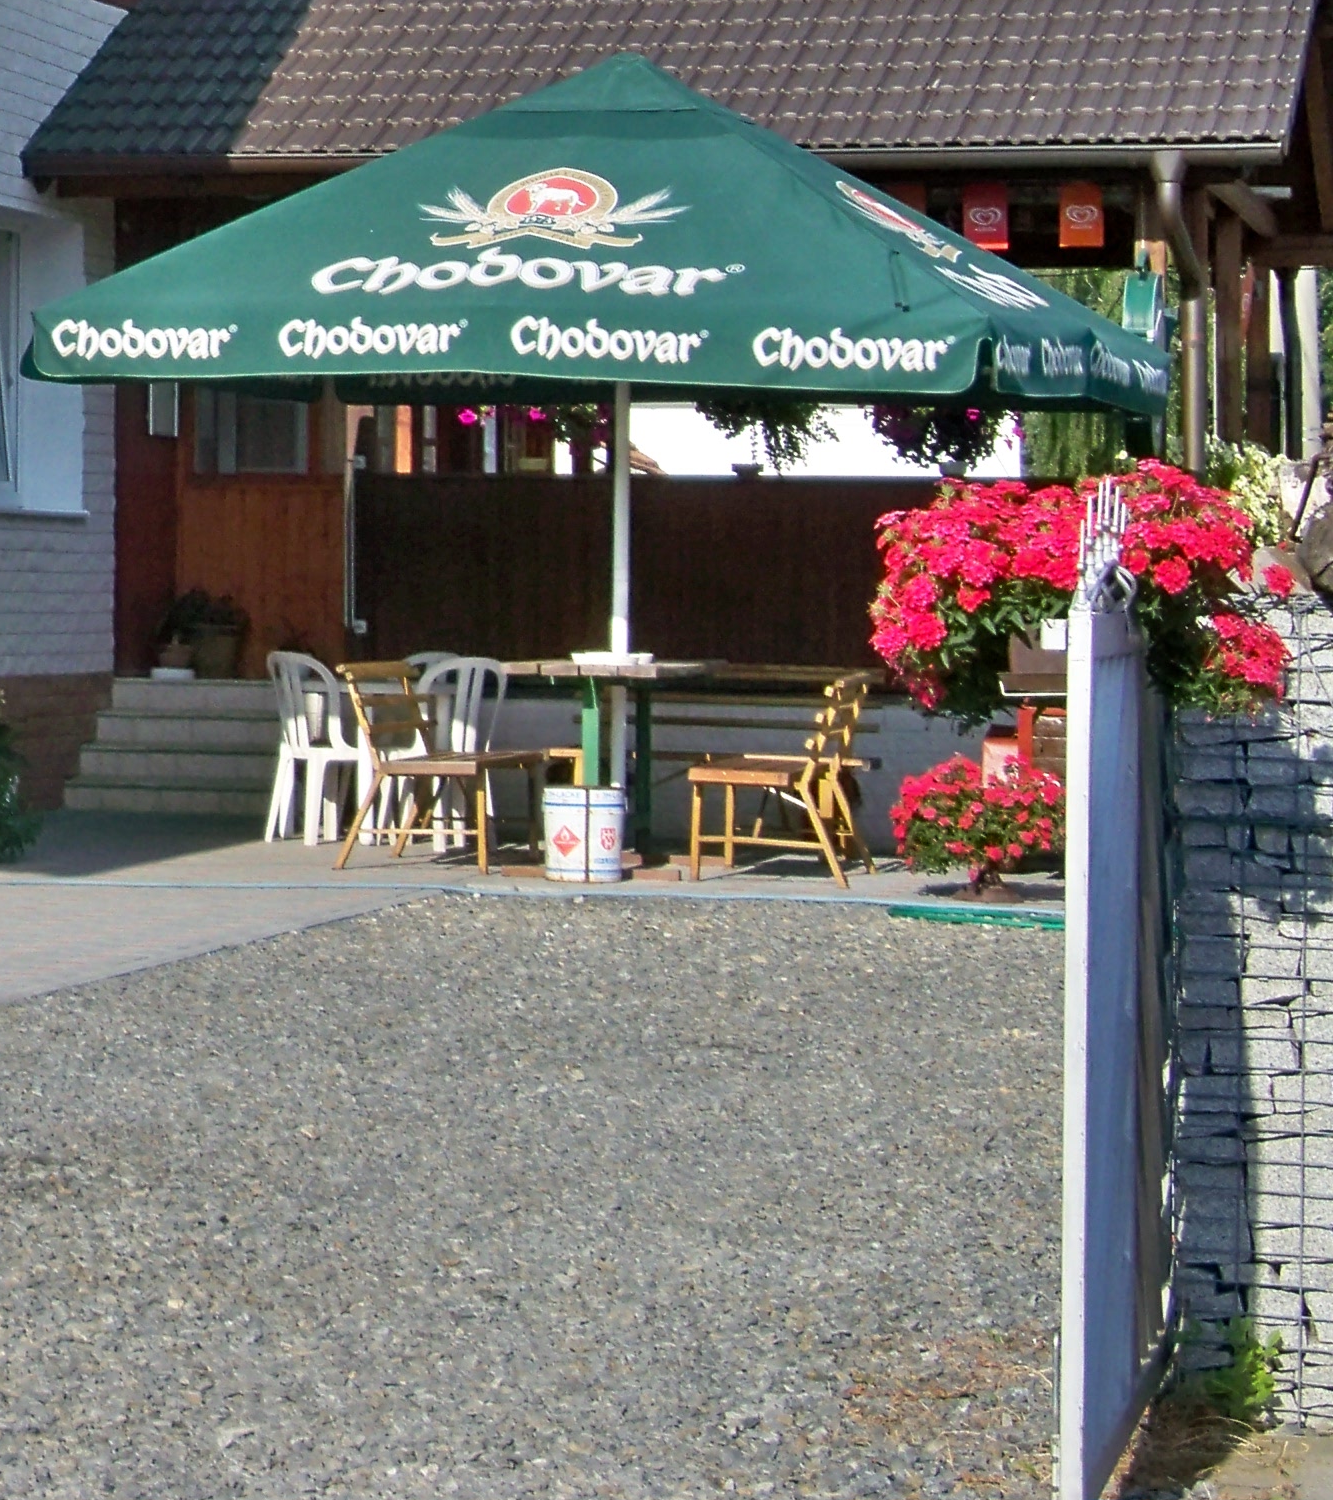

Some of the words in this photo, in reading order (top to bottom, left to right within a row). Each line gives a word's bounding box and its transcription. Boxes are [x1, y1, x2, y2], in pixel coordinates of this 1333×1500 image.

[311, 246, 729, 296] Chodovar
[51, 318, 232, 361] Chodovar
[278, 316, 462, 360] Chodovar
[510, 315, 704, 364] Chodovar
[752, 327, 949, 372] Chodovar
